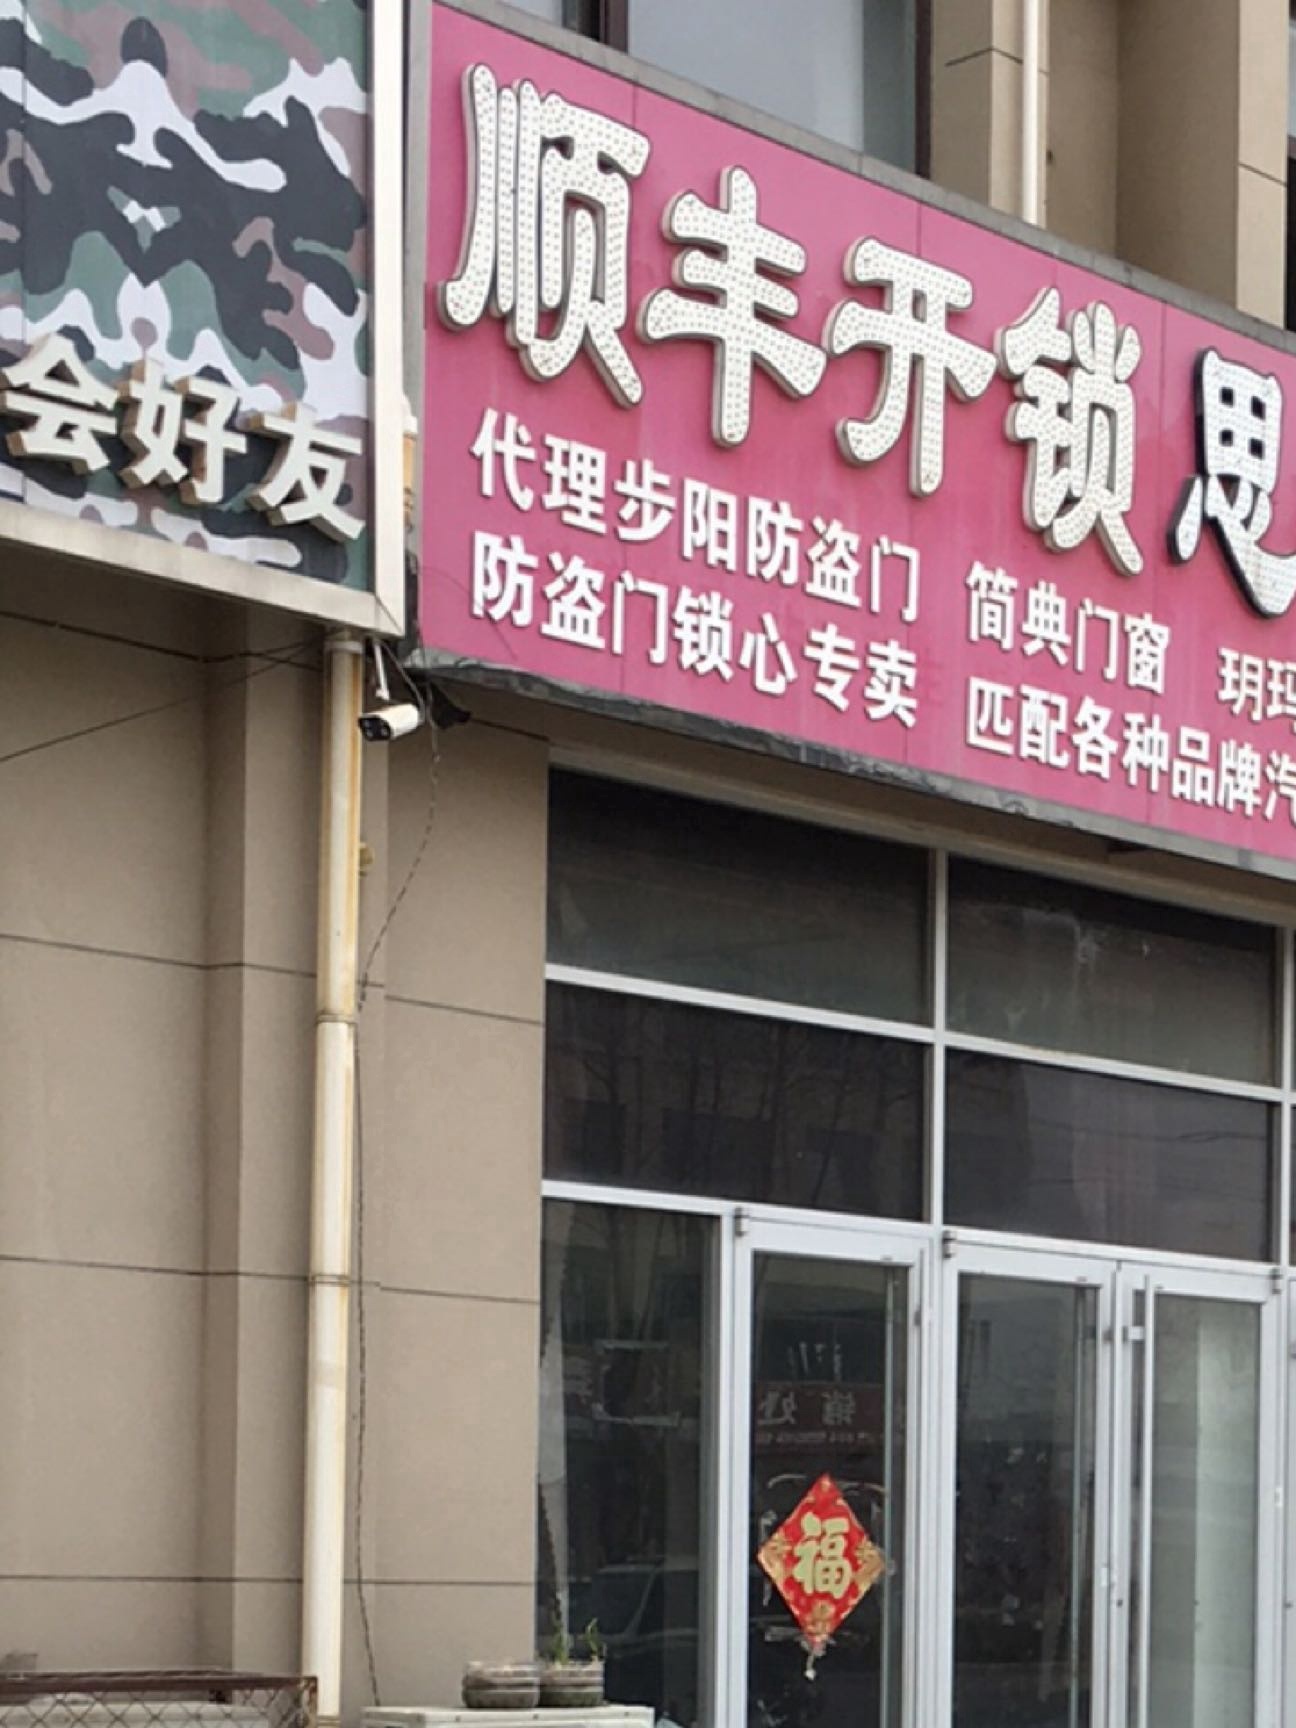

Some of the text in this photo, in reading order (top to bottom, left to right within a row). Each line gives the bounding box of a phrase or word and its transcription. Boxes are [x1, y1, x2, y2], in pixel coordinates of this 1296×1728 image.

[438, 62, 1144, 578] 顺丰开锁
[2, 334, 366, 542] 会好友
[469, 407, 921, 623] 代理步阳防盗门
[471, 529, 918, 728] 防盗门锁心专卖
[966, 561, 1170, 694] 简典门窗
[793, 1511, 852, 1600] 福
